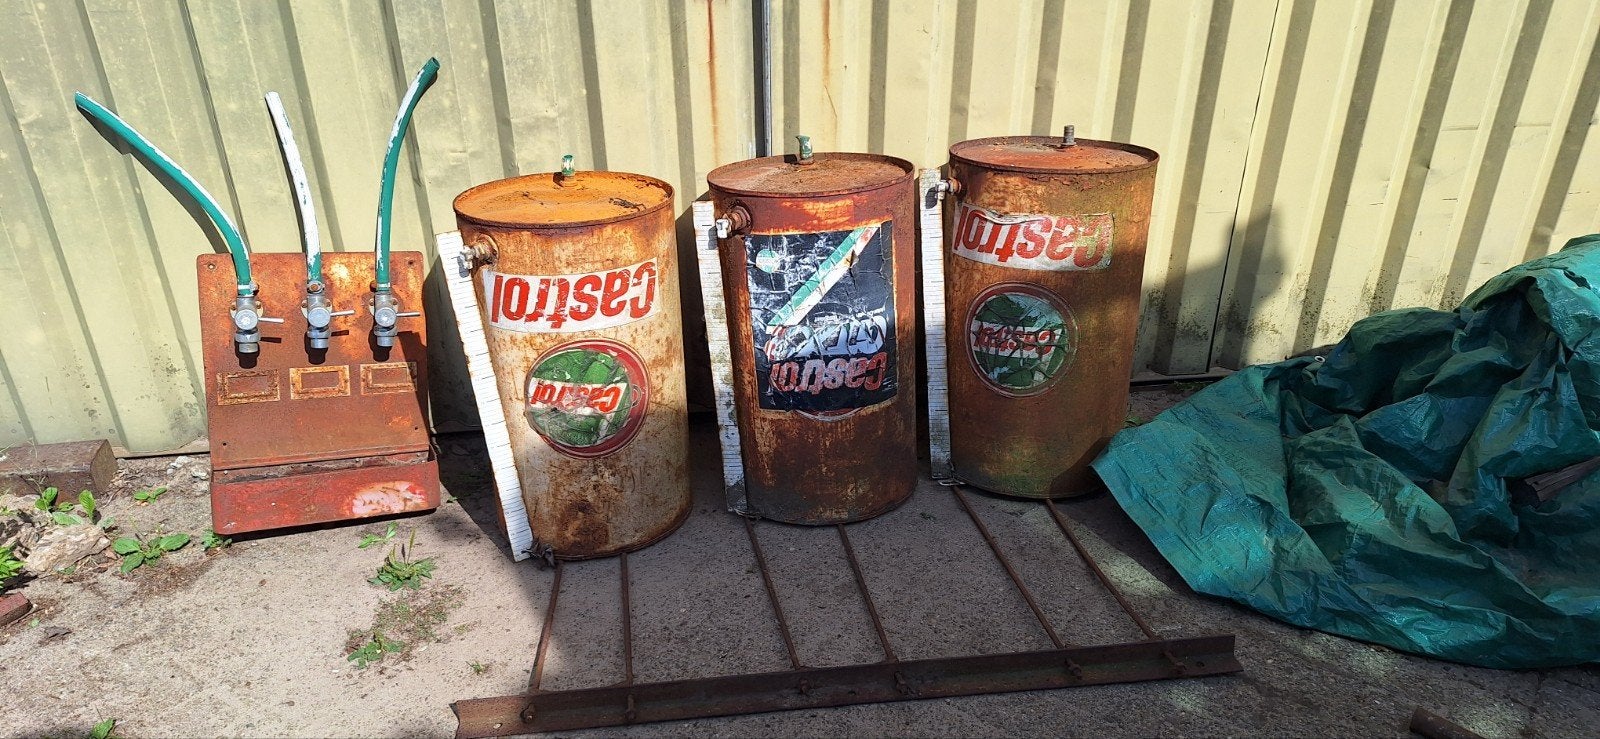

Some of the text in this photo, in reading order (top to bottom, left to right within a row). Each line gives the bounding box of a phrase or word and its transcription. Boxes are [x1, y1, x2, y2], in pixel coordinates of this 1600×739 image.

[954, 206, 1113, 267] Castrol
[491, 261, 656, 329] Castrol
[530, 383, 624, 412] Castrol
[770, 352, 887, 394] Castrol
